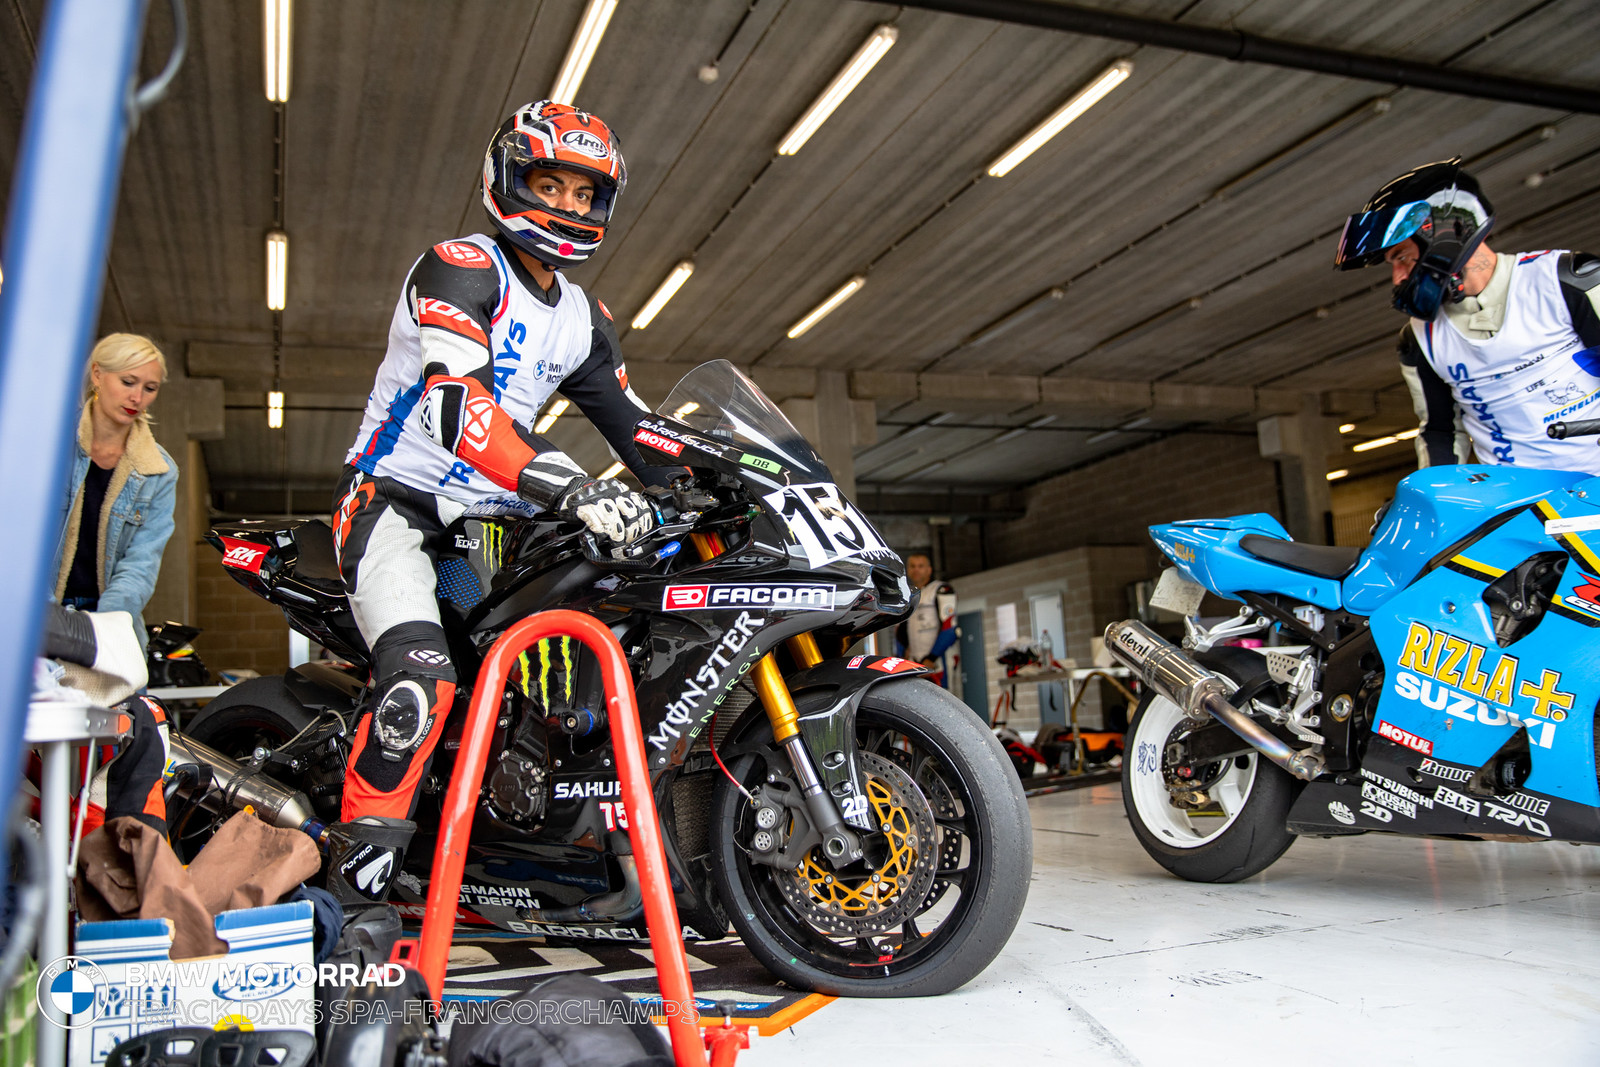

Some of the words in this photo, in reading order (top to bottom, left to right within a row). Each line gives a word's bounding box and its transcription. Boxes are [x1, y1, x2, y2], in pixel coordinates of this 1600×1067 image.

[1525, 380, 1546, 393] LIFE
[636, 433, 680, 454] MOTUL
[638, 420, 723, 457] BARRACUDA
[752, 458, 770, 469] DB
[226, 546, 264, 563] RK
[711, 587, 828, 605] FACOM
[689, 646, 761, 739] ENERGY
[1394, 672, 1556, 749] SUZUKI
[1379, 722, 1431, 754] MOTUL
[1360, 768, 1434, 810] MITSUBISHI
[1359, 800, 1393, 823] 2D
[460, 884, 531, 898] EMAKIN
[477, 895, 541, 909] DEPAN
[507, 920, 706, 943] BARRACUA
